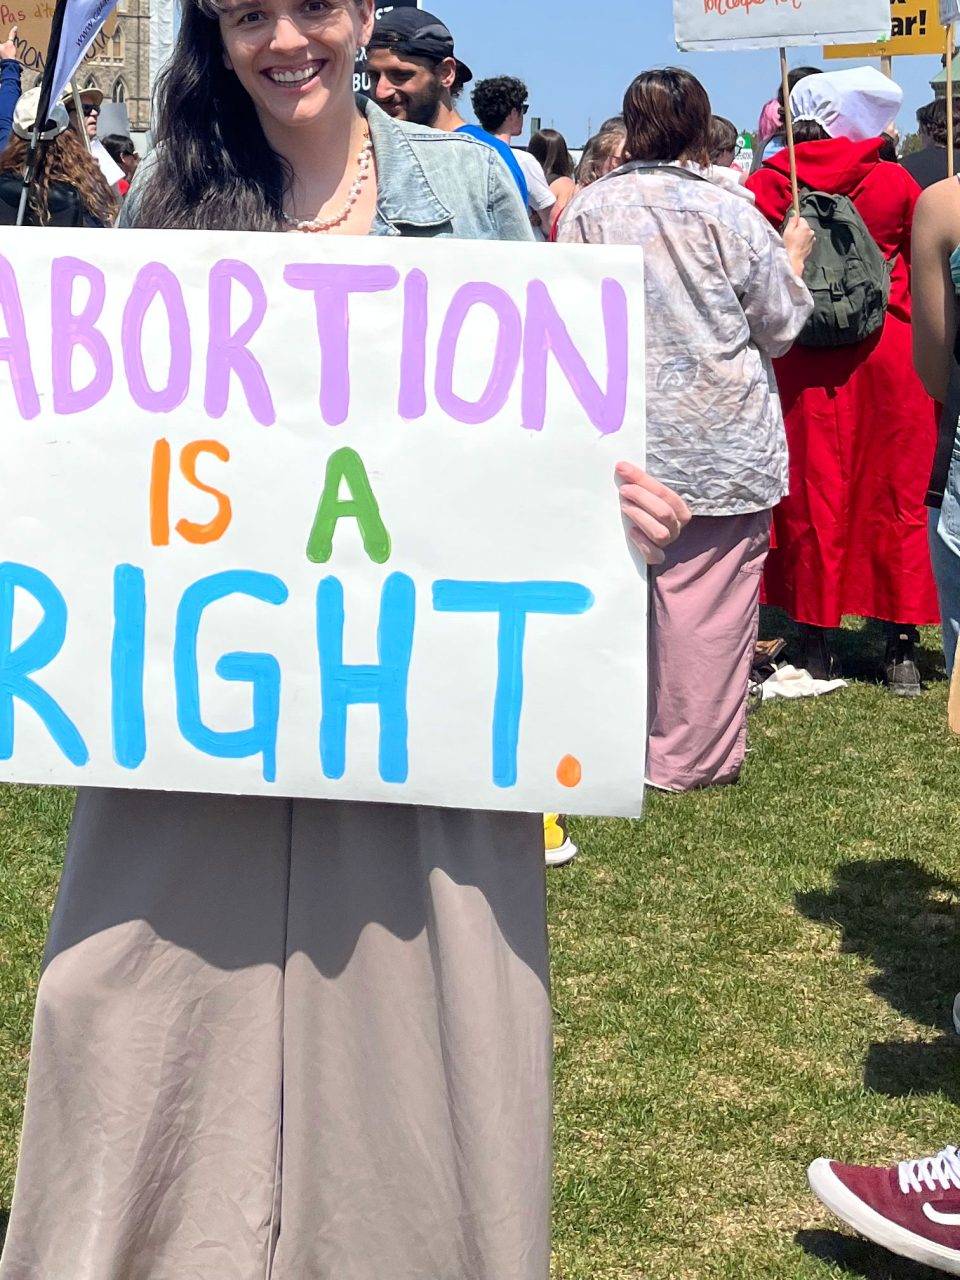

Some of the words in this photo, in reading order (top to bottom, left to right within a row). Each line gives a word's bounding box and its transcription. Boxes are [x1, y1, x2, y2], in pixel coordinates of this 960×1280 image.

[0, 4, 26, 25] Pas
[148, 437, 232, 547] IS
[306, 445, 392, 563] A
